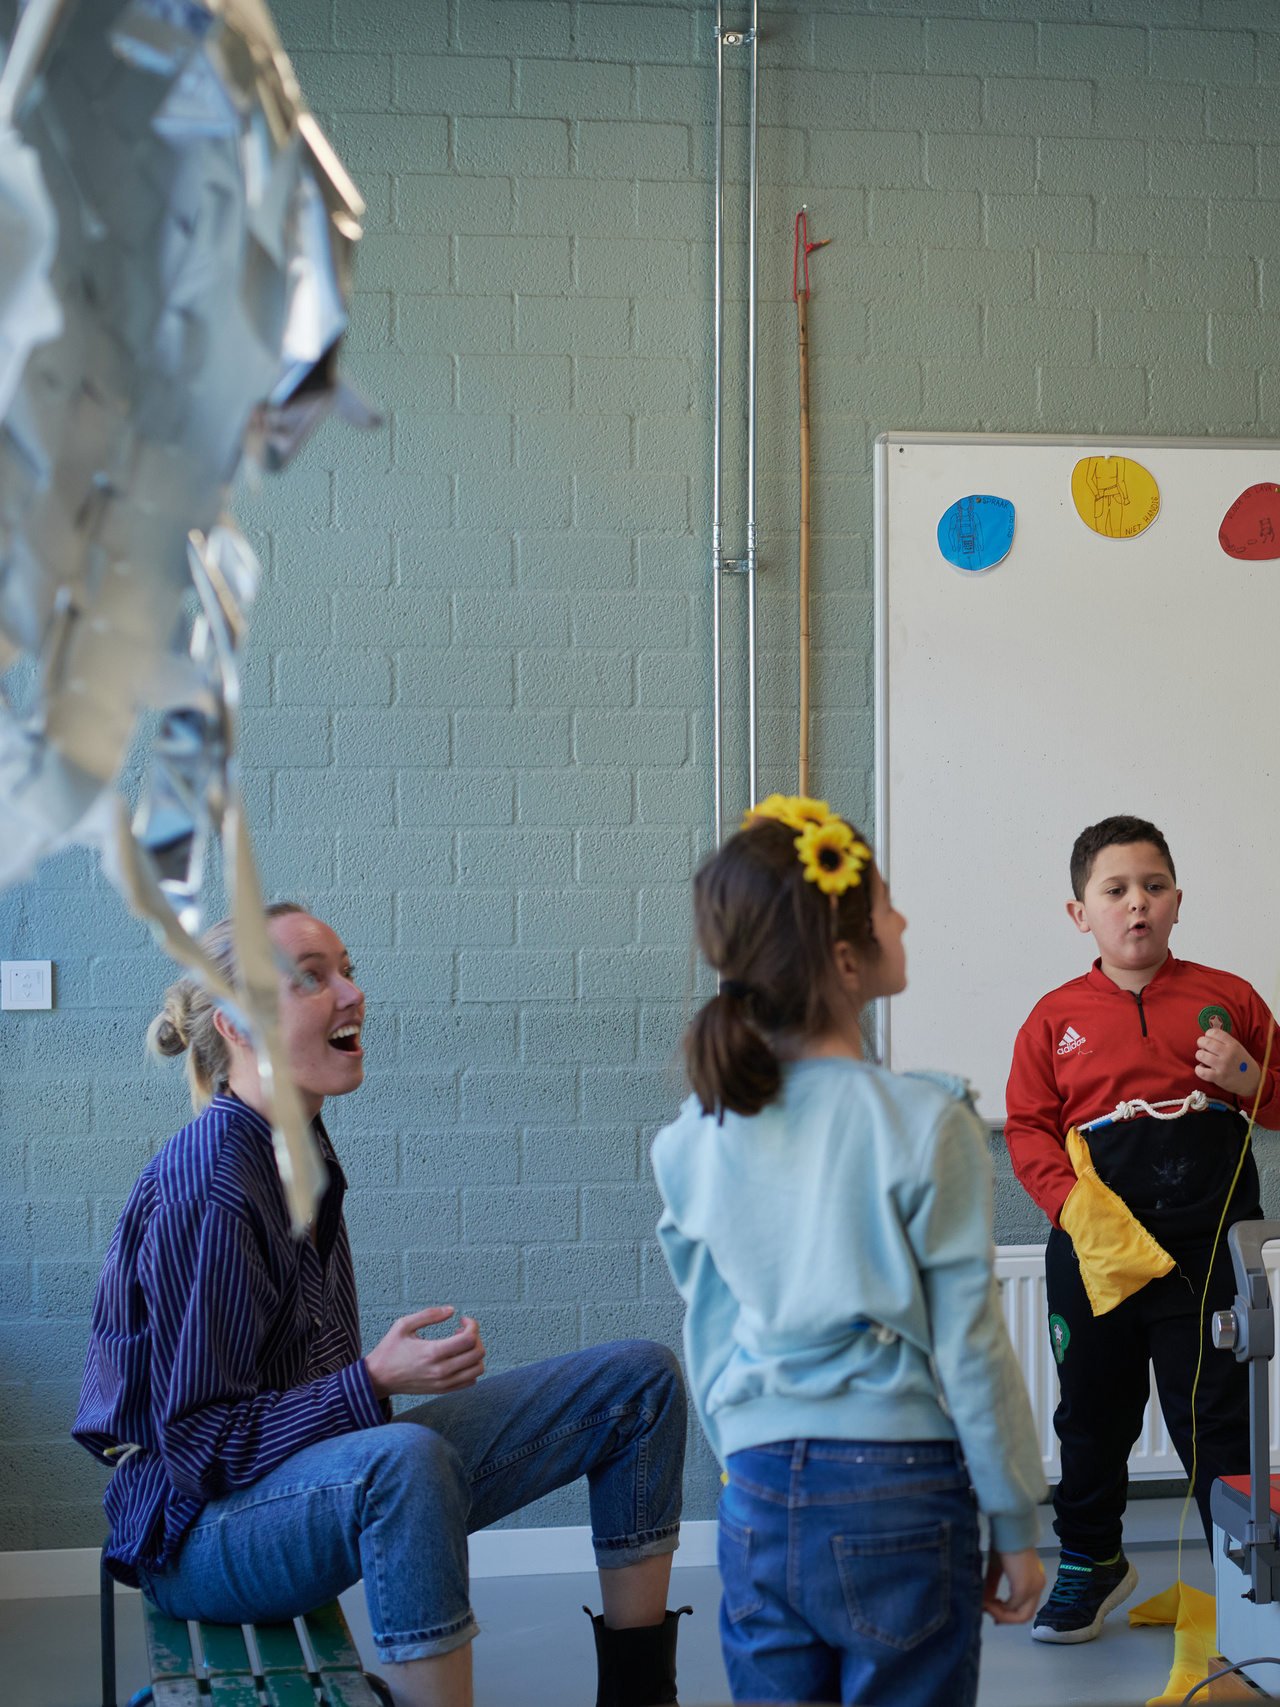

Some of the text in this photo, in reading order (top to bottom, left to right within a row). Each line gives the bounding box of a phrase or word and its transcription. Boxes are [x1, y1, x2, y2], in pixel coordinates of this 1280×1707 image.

[1243, 490, 1252, 499] IS
[1255, 485, 1272, 493] LAVA
[982, 497, 1009, 509] SPRAAK
[1126, 496, 1158, 535] NIET HANDIG
[1056, 1037, 1087, 1055] adidas
